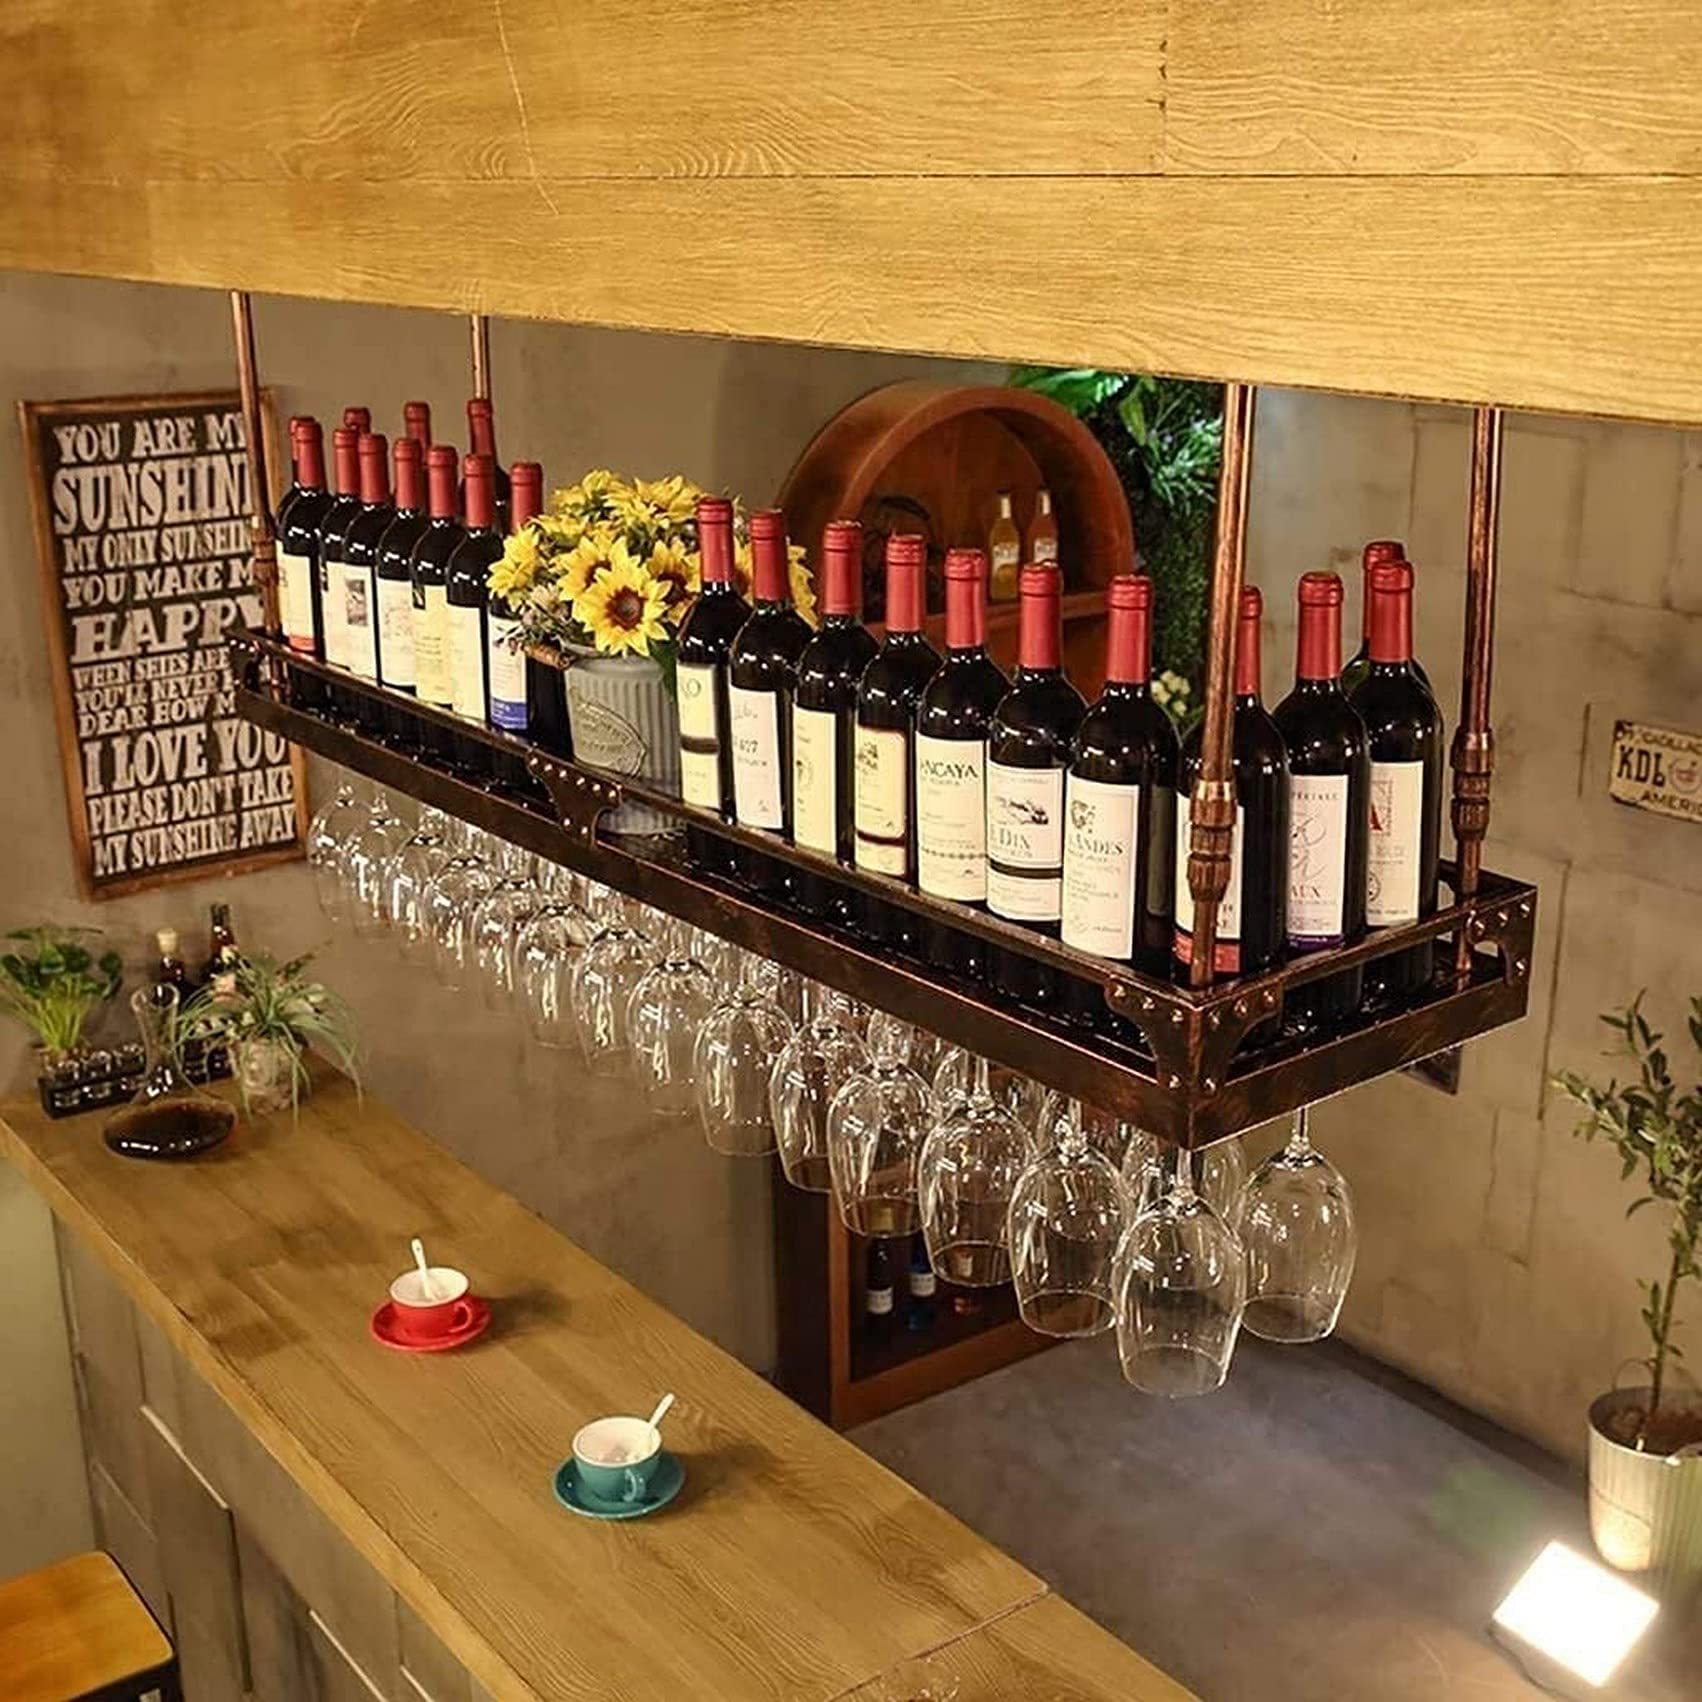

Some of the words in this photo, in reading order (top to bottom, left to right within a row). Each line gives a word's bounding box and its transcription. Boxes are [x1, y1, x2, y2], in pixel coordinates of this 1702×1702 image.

[53, 422, 121, 464] YOU
[132, 418, 197, 458] ARE
[63, 535, 99, 574] MY
[103, 528, 158, 569] ONLY
[63, 571, 129, 609] YOU
[133, 560, 223, 601] MAKE
[72, 660, 132, 691] WHEN
[191, 646, 231, 672] ARE
[151, 672, 219, 702] NEVER
[79, 704, 148, 738] DEAR
[152, 694, 209, 725] HOW
[83, 740, 104, 796] I
[111, 723, 208, 792] LOVE
[213, 717, 288, 773] YOU
[88, 785, 170, 837] PLEASE
[171, 775, 237, 822] DON'T
[238, 765, 294, 810] TAKE
[93, 833, 128, 877] MY
[130, 812, 238, 870] SUNSHINE
[239, 802, 296, 850] AWAY
